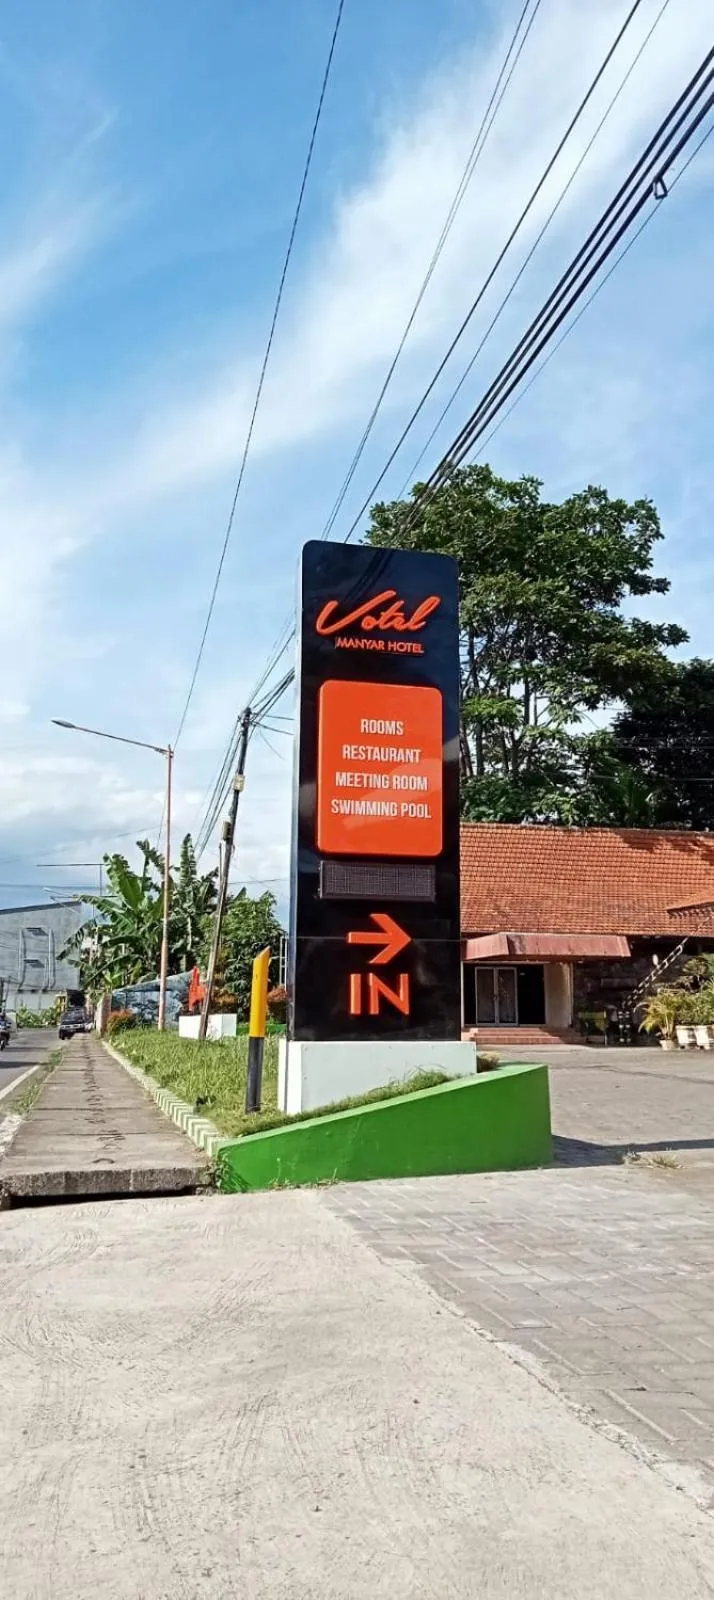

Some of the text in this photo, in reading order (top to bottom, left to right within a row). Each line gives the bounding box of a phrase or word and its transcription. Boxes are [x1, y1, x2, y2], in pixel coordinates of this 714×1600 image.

[316, 590, 440, 635] Votel
[335, 637, 424, 654] MANYAR HOTEL
[360, 718, 404, 735] ROOMS
[342, 744, 421, 763] RESTAURANT
[335, 772, 428, 791] MEETING ROOM
[331, 799, 432, 818] SWIMMING POOL
[350, 972, 410, 1015] IN
